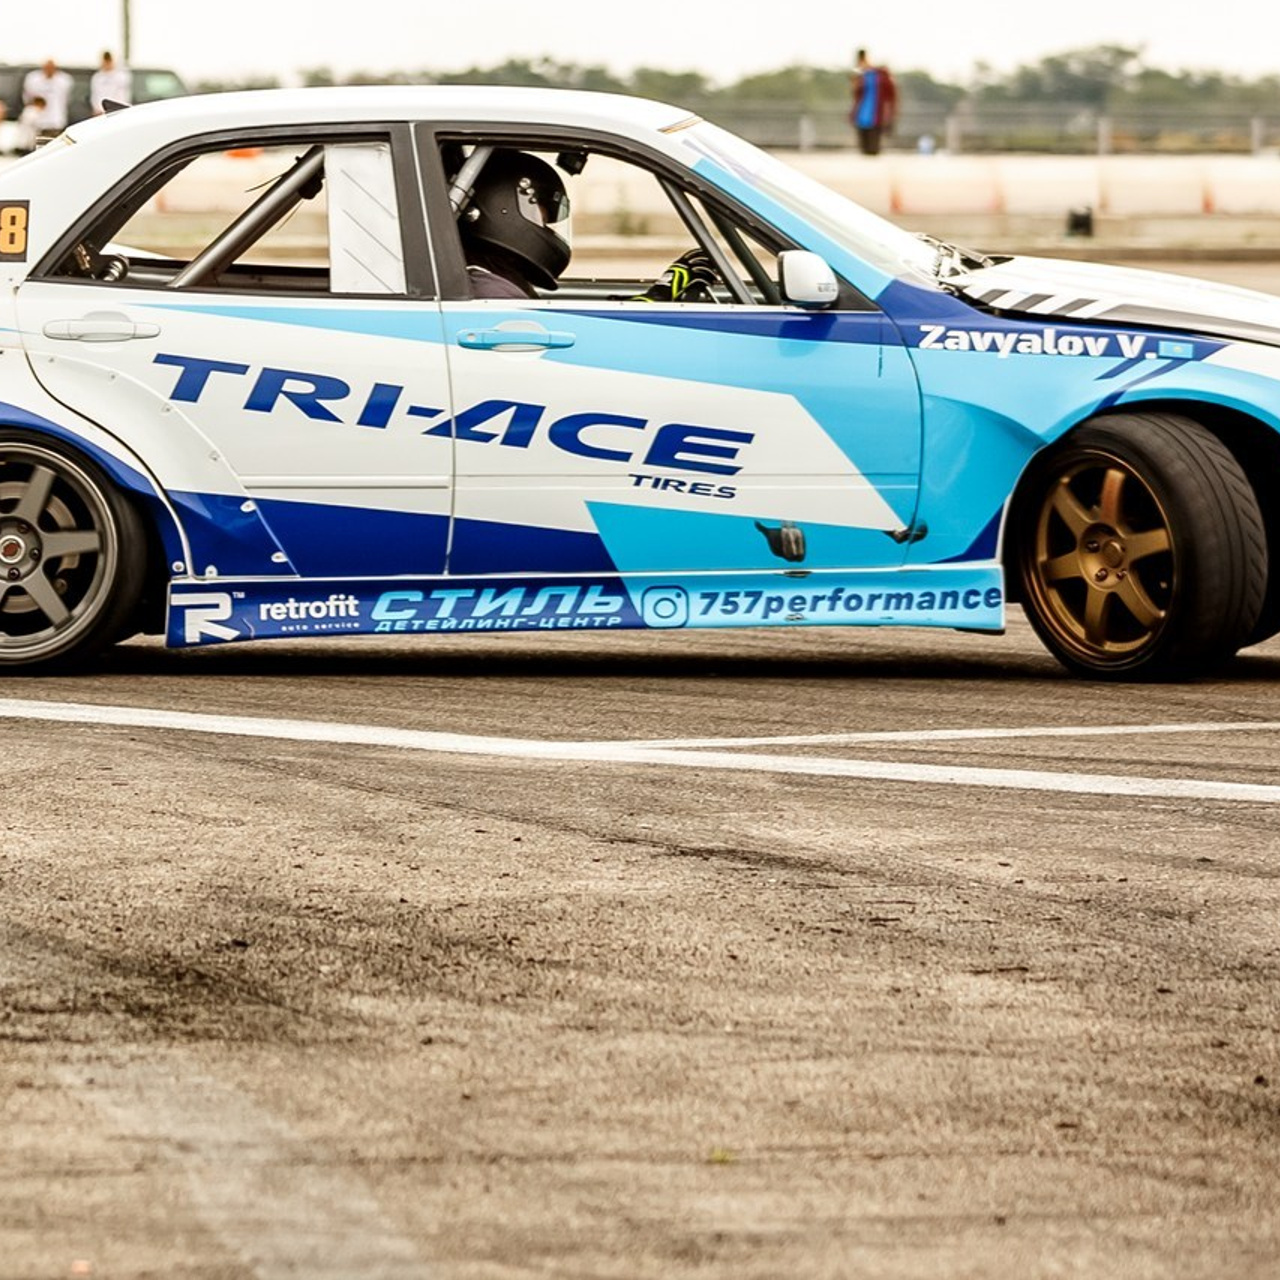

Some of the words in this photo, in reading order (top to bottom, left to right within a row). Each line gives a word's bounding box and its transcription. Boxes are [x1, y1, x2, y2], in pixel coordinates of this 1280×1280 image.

[919, 324, 1110, 359] Zavyalov
[1116, 333, 1157, 359] V.
[152, 353, 755, 476] TRI-ACE
[627, 474, 737, 500] TIRES
[259, 594, 360, 620] retrofit
[371, 585, 624, 620] СТИЛЬ
[699, 586, 1002, 619] 757performance
[314, 622, 360, 630] service
[374, 616, 622, 632] ДЕТЕЙЛИНГ-ЦЕНТР
